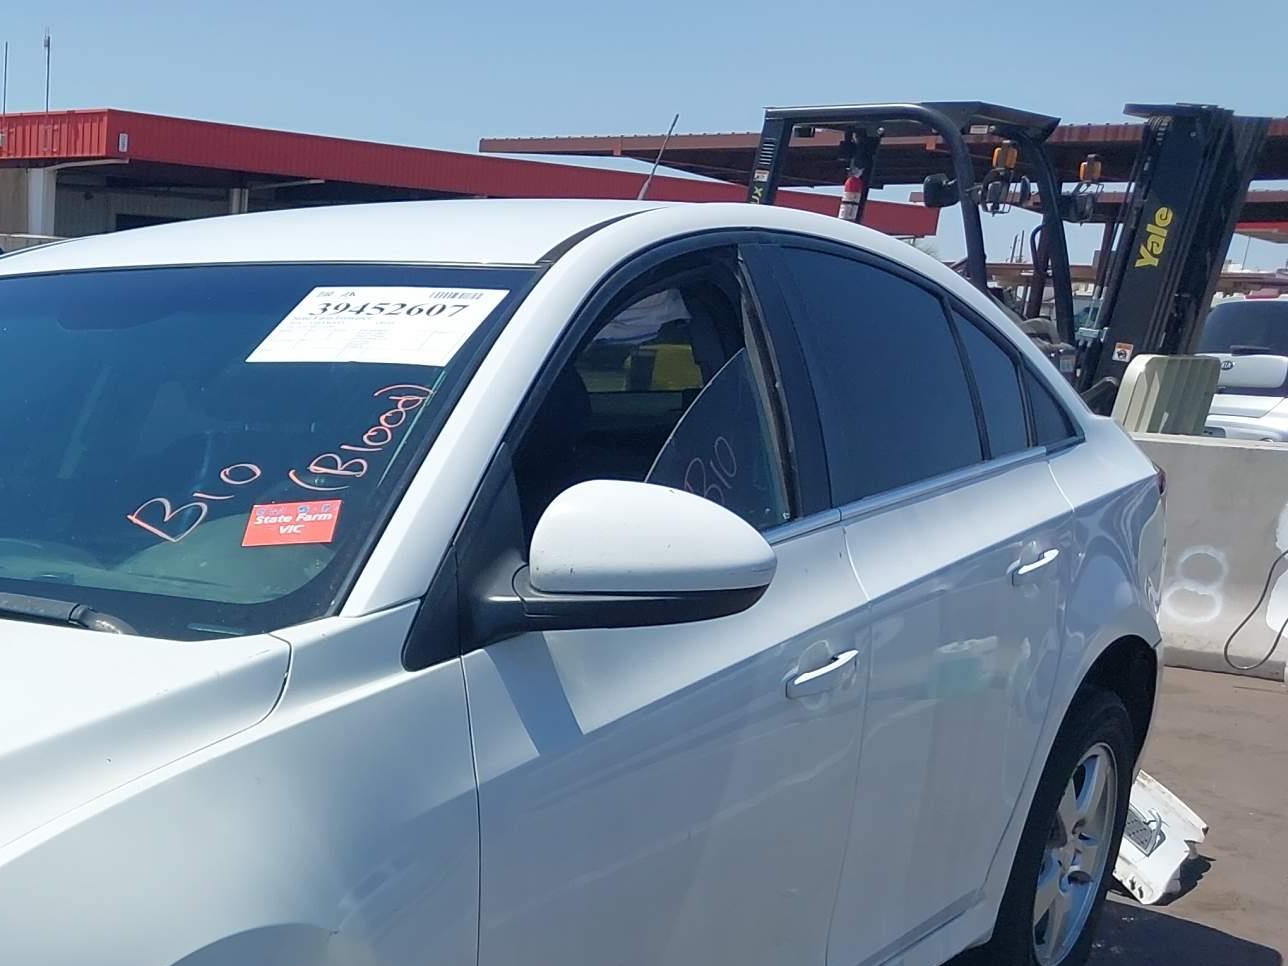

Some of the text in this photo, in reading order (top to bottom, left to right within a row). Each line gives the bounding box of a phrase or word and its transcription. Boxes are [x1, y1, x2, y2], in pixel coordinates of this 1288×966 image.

[1135, 206, 1173, 268] Yale
[309, 302, 470, 318] 39452607
[254, 512, 333, 525] State Farm
[279, 524, 305, 534] VIC
